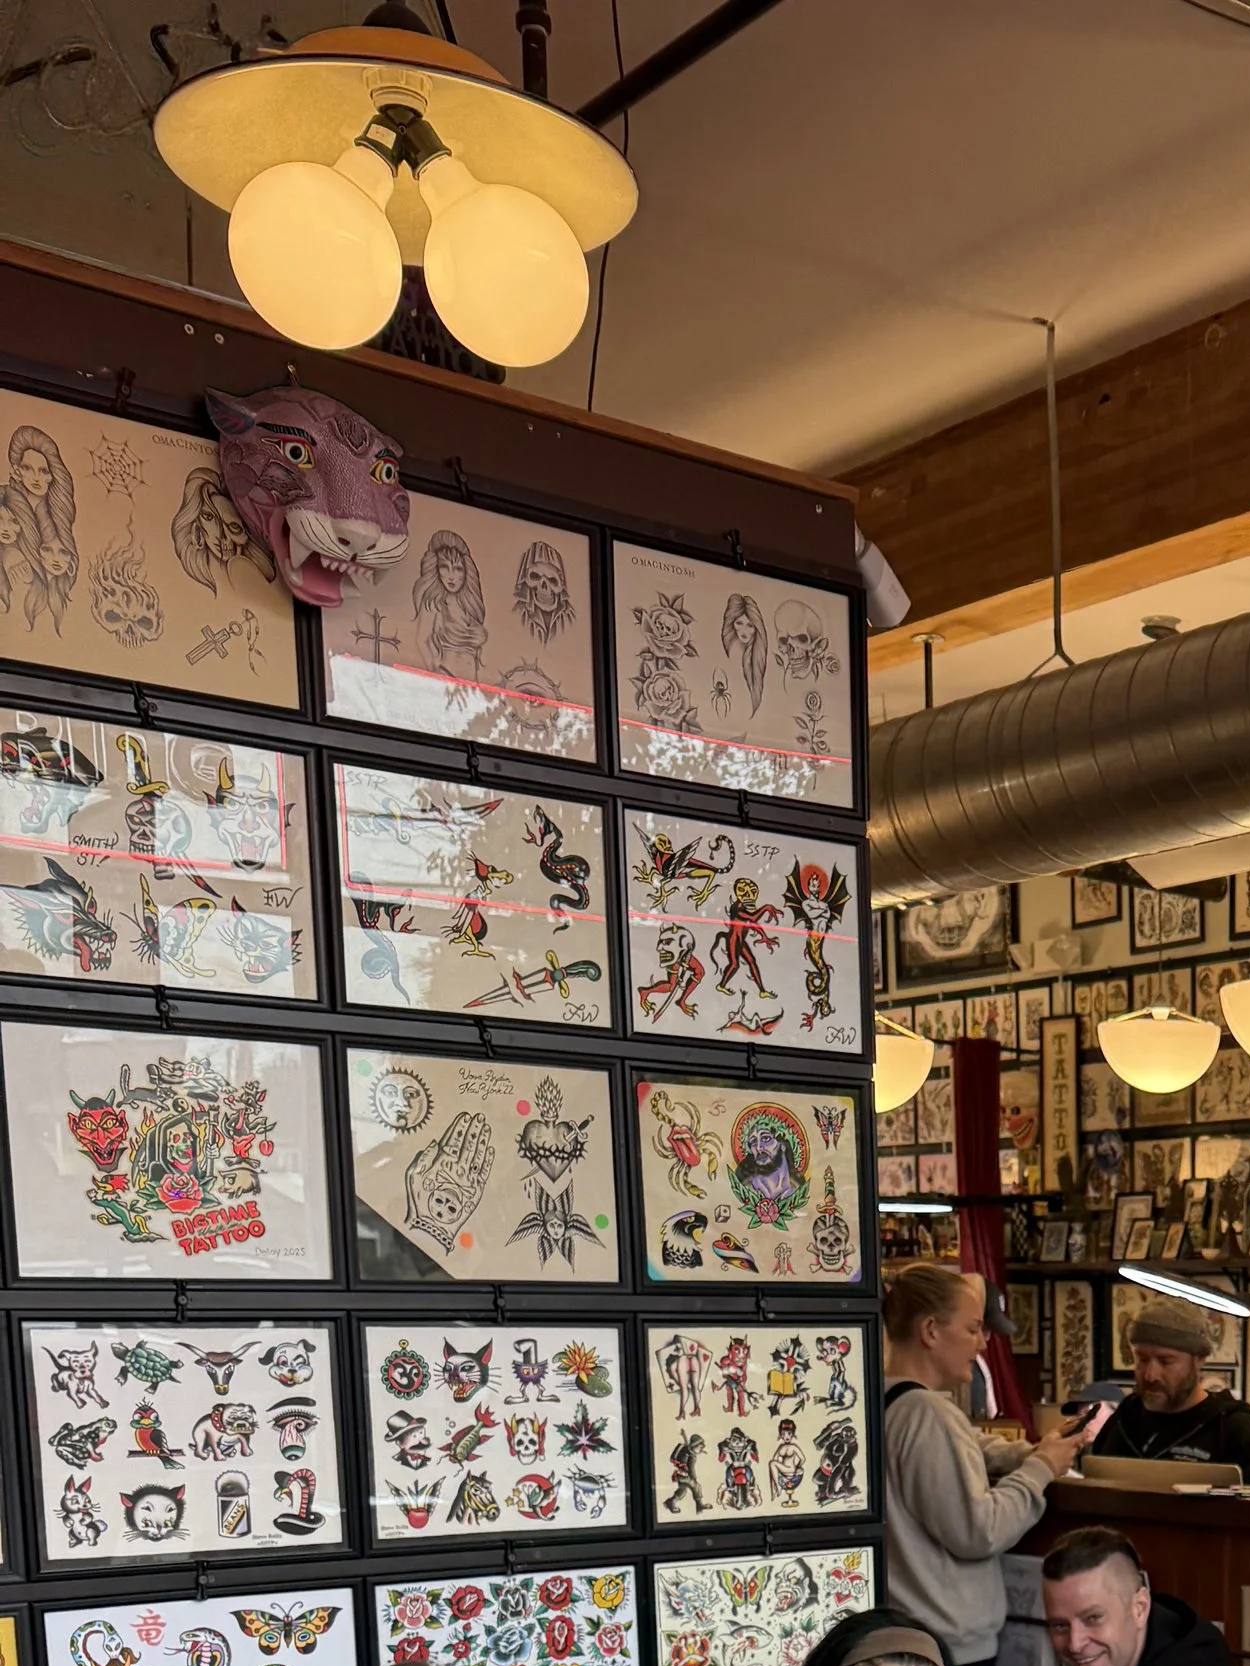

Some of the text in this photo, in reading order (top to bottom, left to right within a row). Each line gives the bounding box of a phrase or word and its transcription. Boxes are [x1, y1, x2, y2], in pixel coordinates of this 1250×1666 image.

[68, 831, 119, 850] SMITH
[1052, 1033, 1071, 1160] TATTO
[171, 1200, 262, 1239] BIGTIME
[178, 1219, 266, 1257] TATTOO
